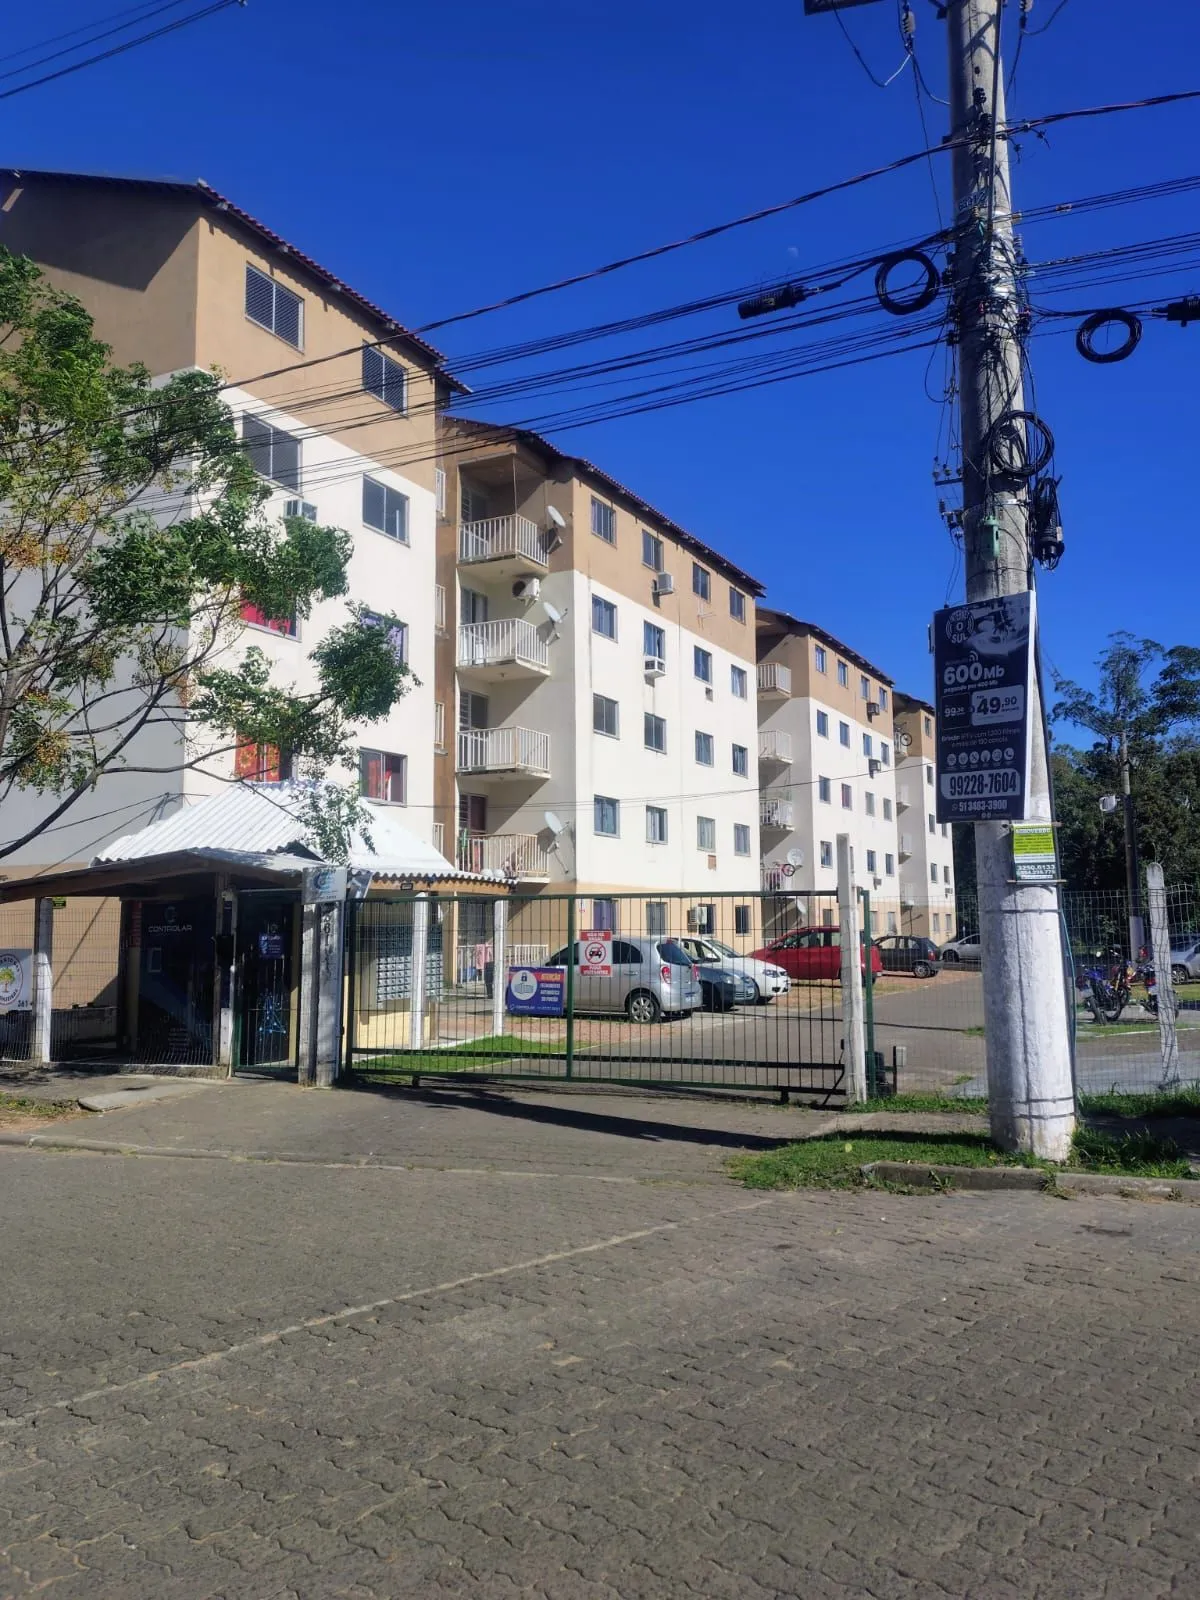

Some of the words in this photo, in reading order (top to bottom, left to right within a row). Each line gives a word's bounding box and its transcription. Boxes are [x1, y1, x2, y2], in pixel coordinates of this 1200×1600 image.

[956, 622, 964, 631] O
[951, 632, 968, 644] SUL
[949, 772, 1017, 796] 99228-7604
[148, 924, 193, 933] CONTROLAR
